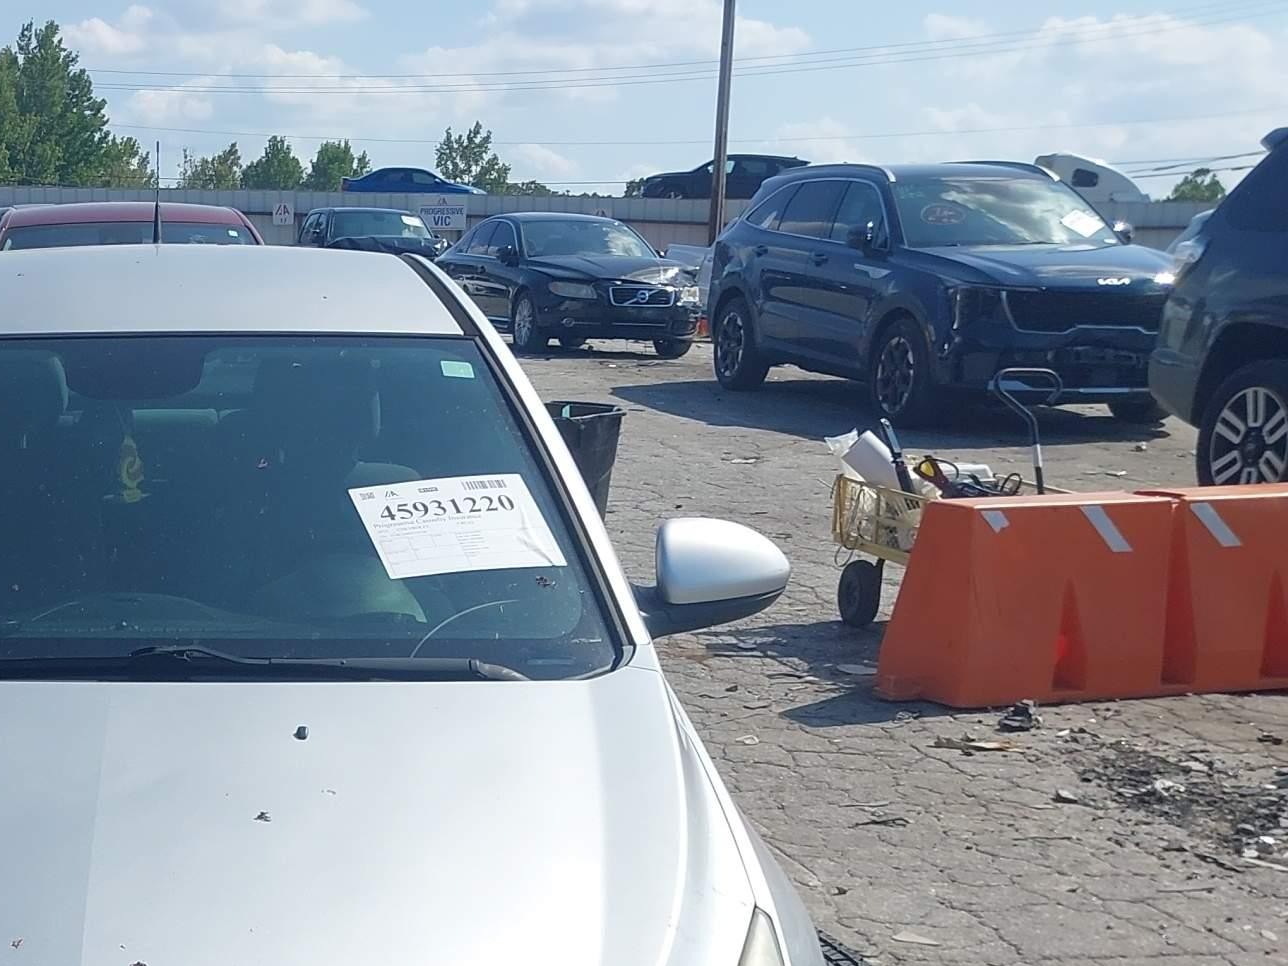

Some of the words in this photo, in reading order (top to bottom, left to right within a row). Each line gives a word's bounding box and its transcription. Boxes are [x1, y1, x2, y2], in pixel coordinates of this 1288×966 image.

[420, 207, 464, 215] PROGRESSIVE
[433, 215, 451, 226] VIC
[380, 494, 515, 521] 45931220
